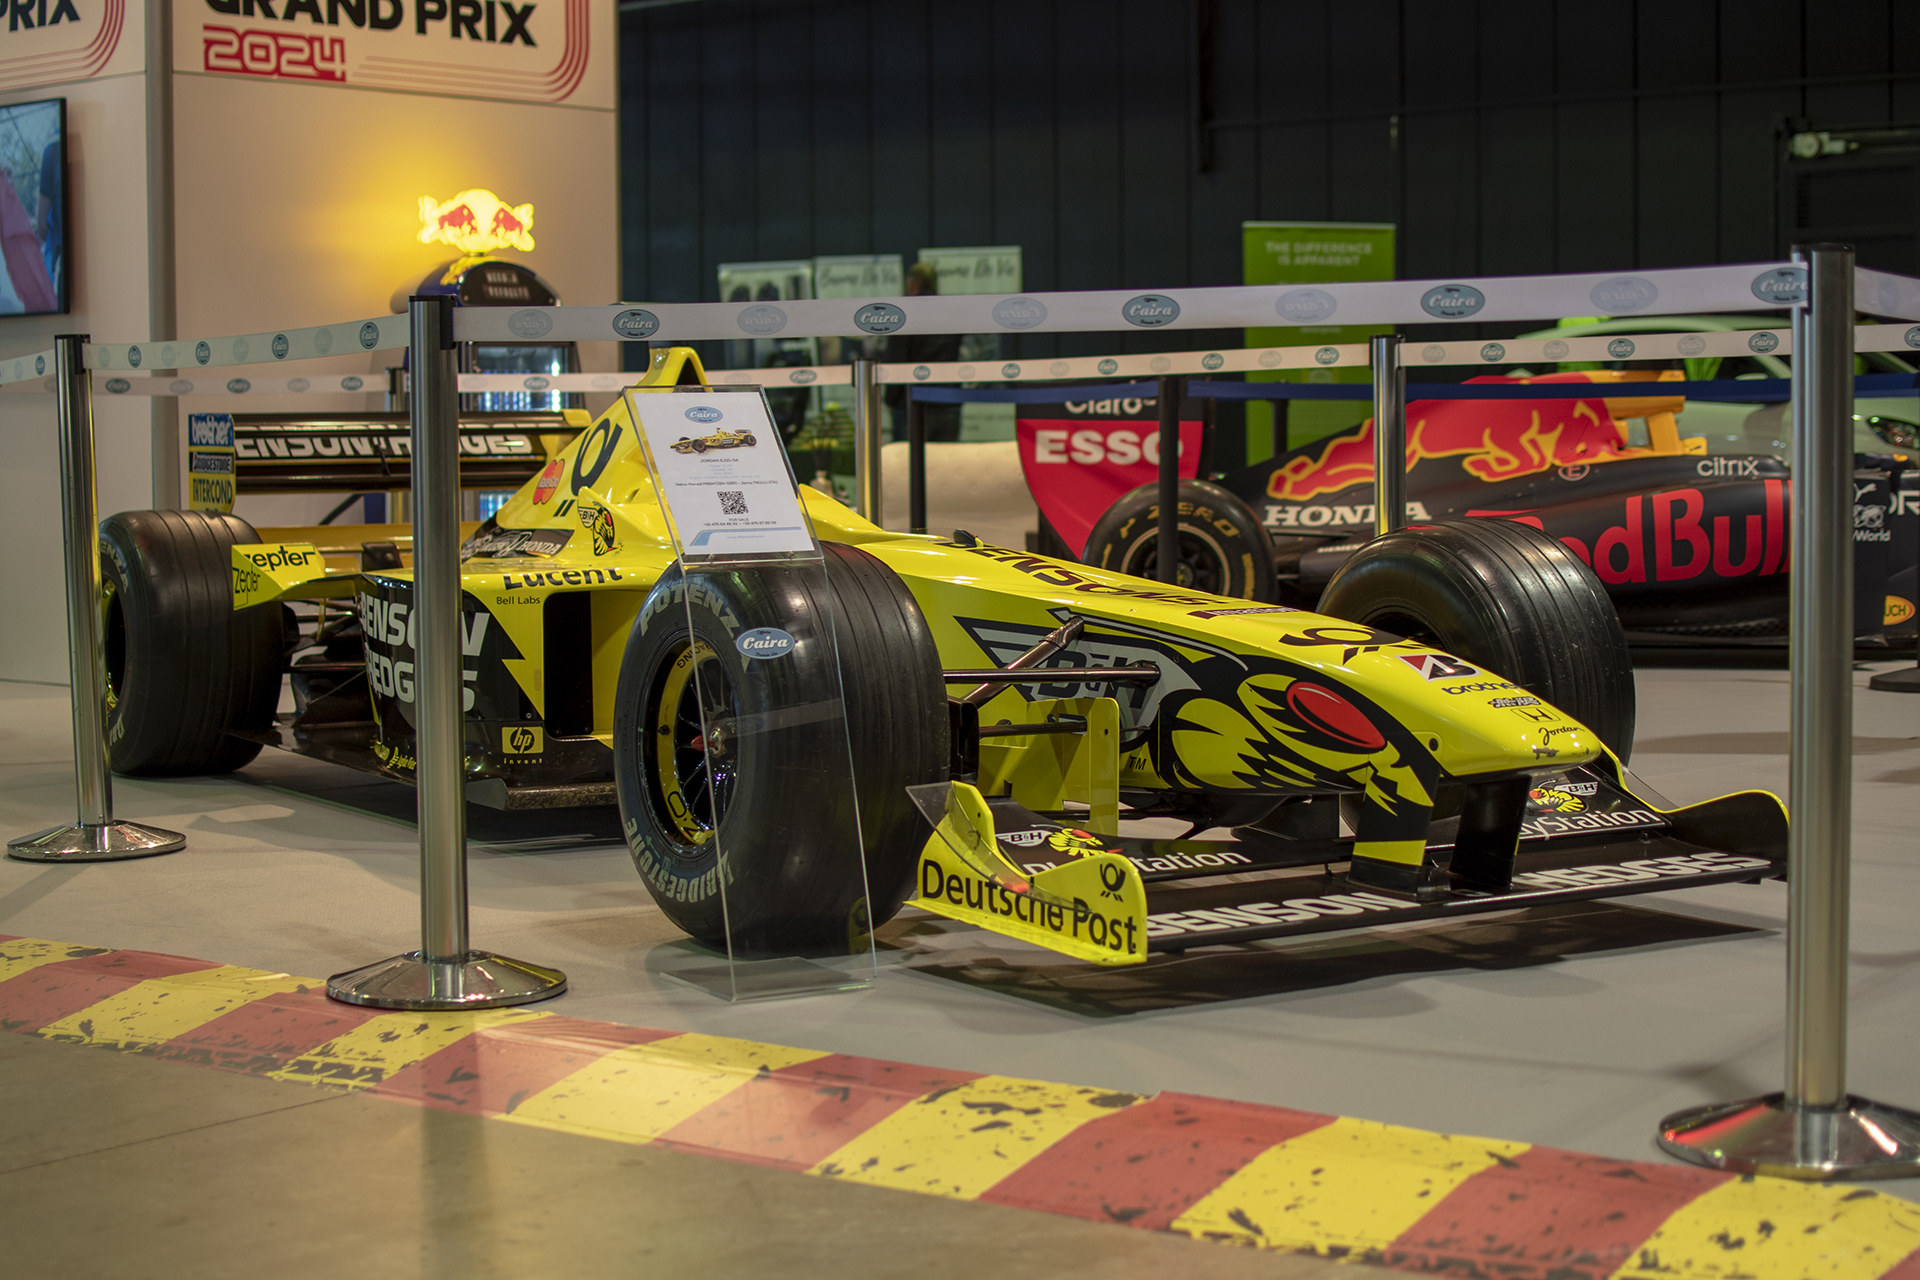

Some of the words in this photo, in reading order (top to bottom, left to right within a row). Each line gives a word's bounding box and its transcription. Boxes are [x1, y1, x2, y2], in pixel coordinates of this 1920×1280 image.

[0, 0, 81, 32] RIX
[415, 0, 537, 47] PRIX
[203, 24, 346, 82] 2024
[1265, 242, 1290, 253] THE
[1294, 242, 1373, 254] DIFFERENCE
[1278, 255, 1290, 265] IS
[1294, 255, 1360, 266] APPARENT
[1129, 303, 1173, 317] Caira
[1428, 293, 1477, 308] Caira
[618, 317, 655, 330] Caira
[860, 311, 900, 325] Caira
[1611, 342, 1633, 353] Caira
[1752, 336, 1775, 348] Caira
[191, 415, 231, 445] brother
[234, 424, 375, 457] ENSON
[388, 423, 533, 456] HGES
[1035, 430, 1183, 465] ESSO
[193, 452, 231, 473] BRIDGESTONE
[1697, 457, 1760, 476] citrix
[192, 478, 233, 504] INTERCOND
[518, 541, 562, 554] HONDA
[100, 541, 129, 595] ENZA
[503, 567, 623, 590] Lucent
[232, 567, 260, 604] zepter
[496, 596, 515, 605] Bell
[517, 596, 541, 605] Labs
[360, 591, 490, 657] BENSN
[743, 635, 790, 650] Caira
[366, 647, 478, 713] HEDGS
[1538, 725, 1586, 746] Jordan
[1129, 757, 1147, 771] TM
[1520, 808, 1662, 841] ayStation
[1022, 851, 1253, 873] Pltation
[1512, 852, 1772, 889] HEDGES
[922, 858, 1064, 931] Deutsche
[1073, 897, 1138, 955] Post
[1147, 892, 1422, 938] BENSON
